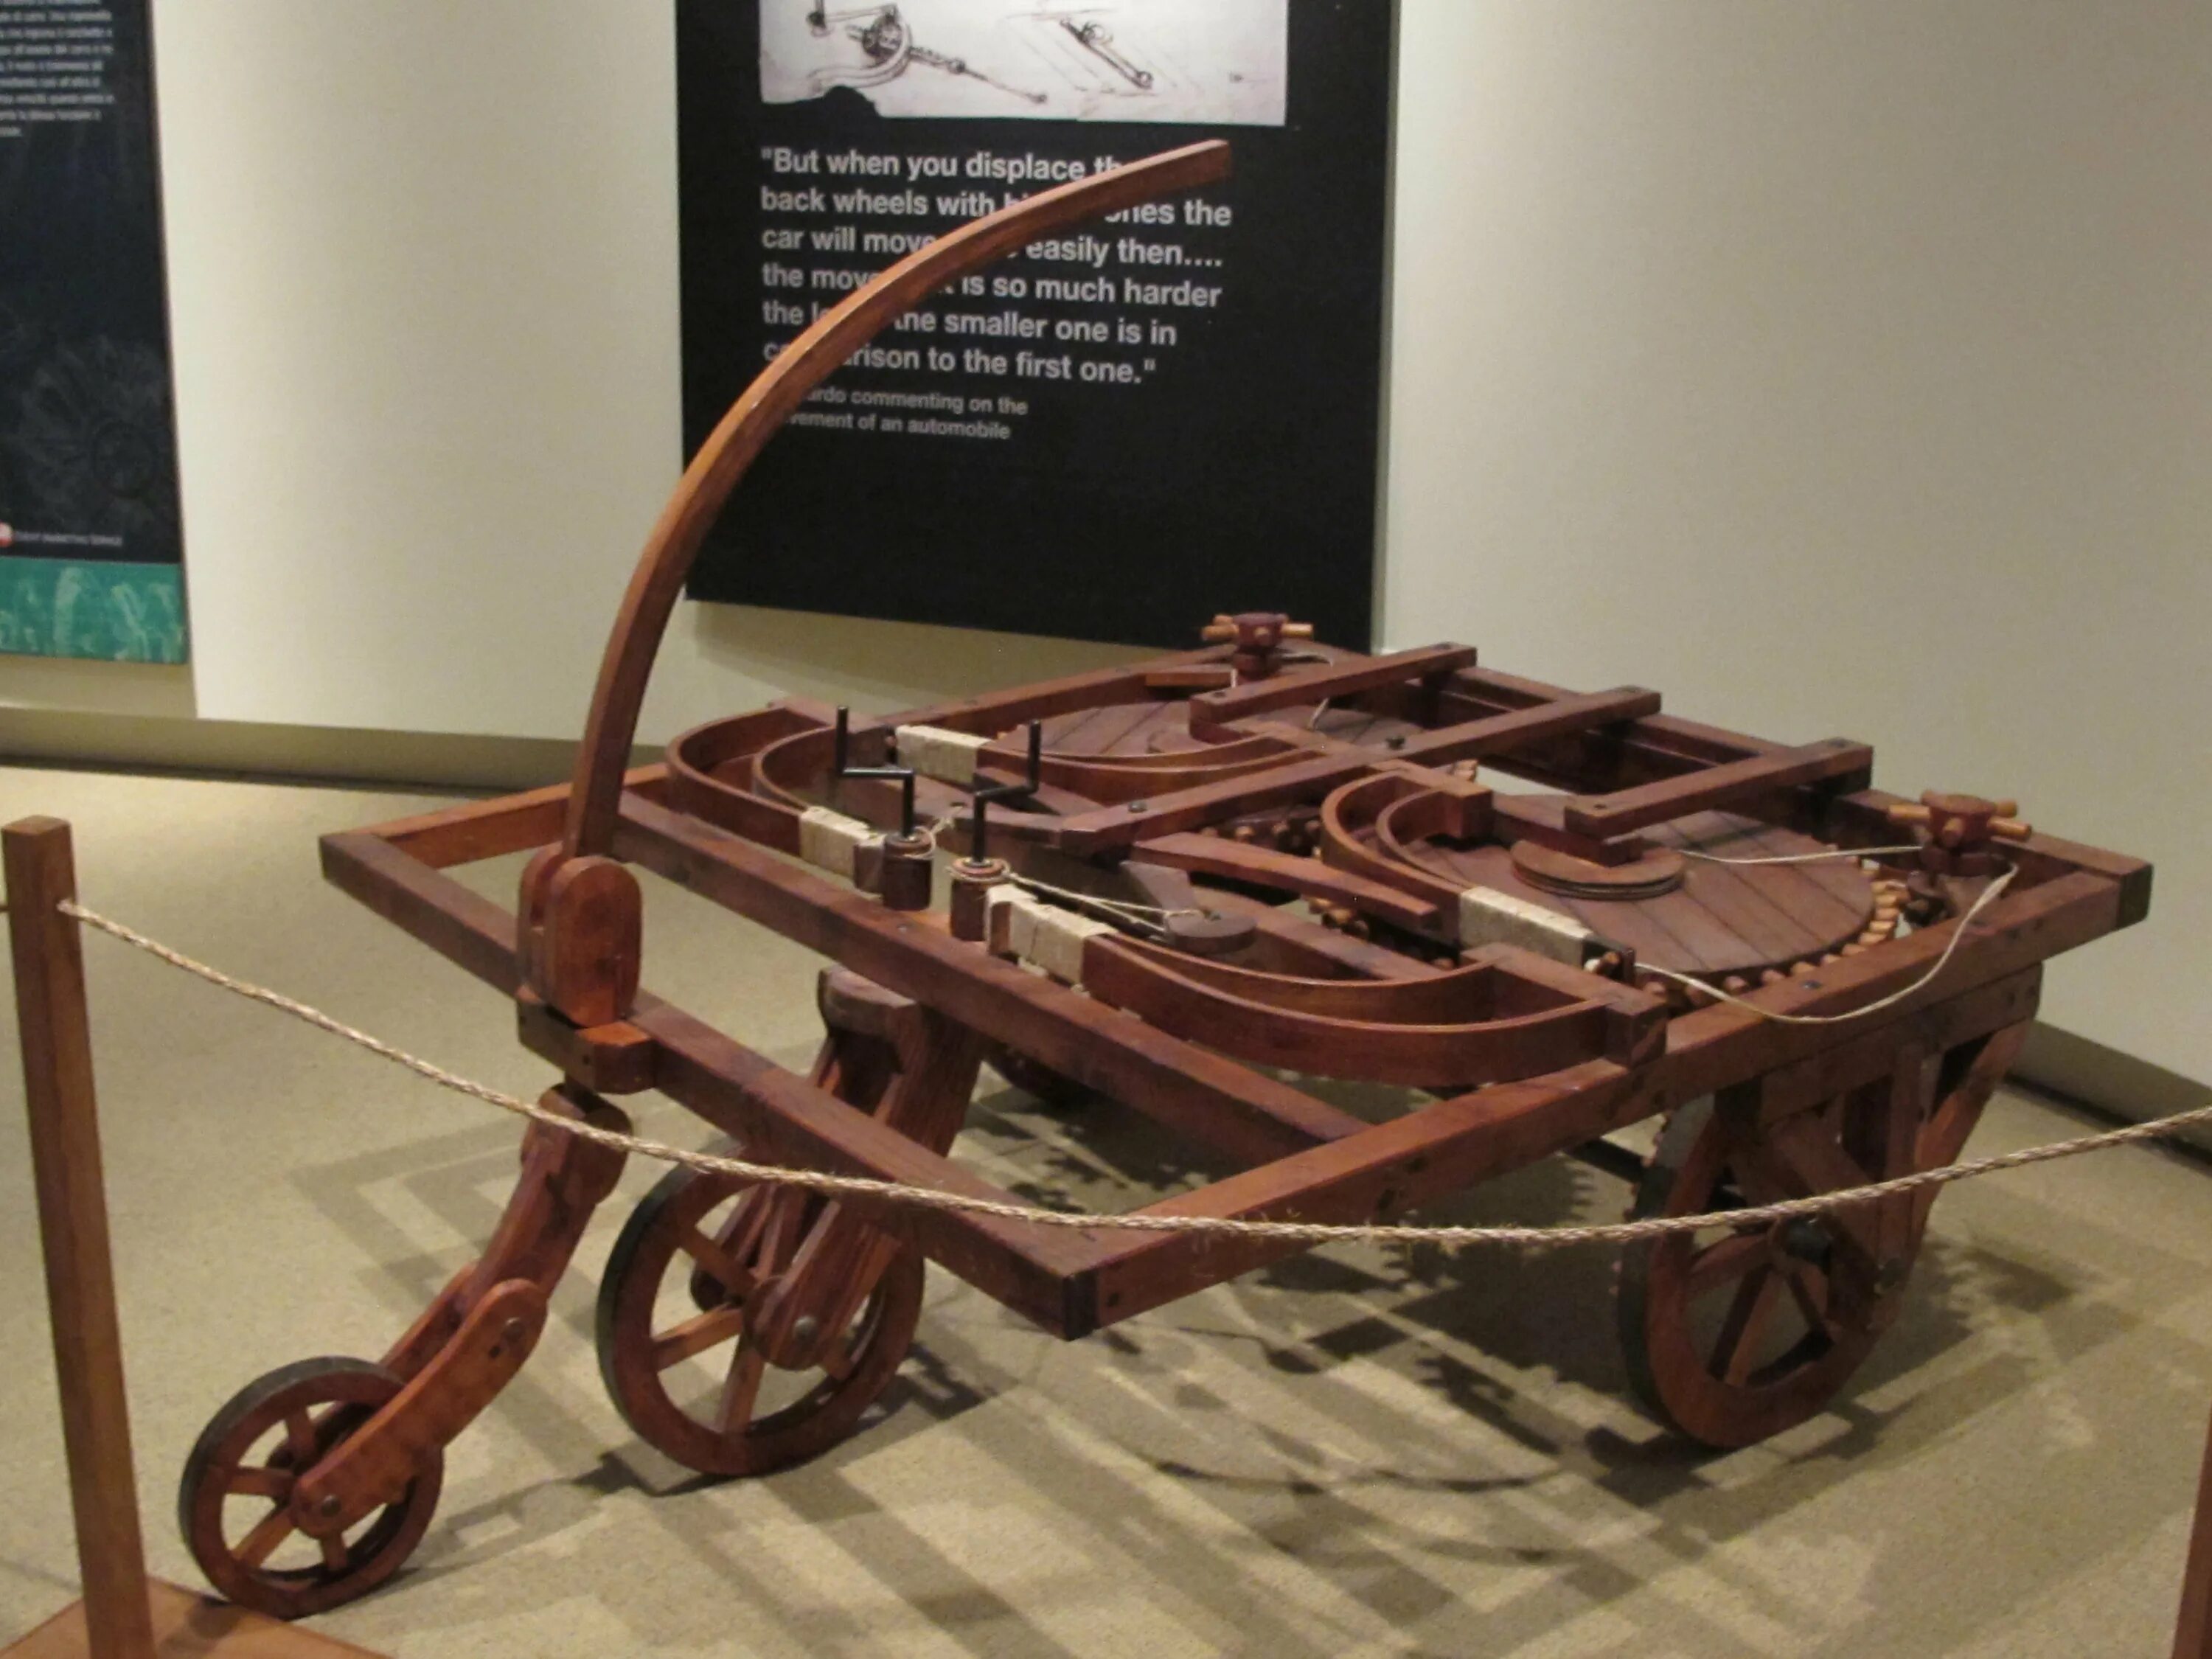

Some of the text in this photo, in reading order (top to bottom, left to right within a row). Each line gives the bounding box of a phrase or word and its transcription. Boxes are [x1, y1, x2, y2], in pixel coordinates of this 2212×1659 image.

[761, 147, 1125, 184] "But when you displace th
[761, 186, 826, 211] back
[833, 189, 929, 215] wheels
[936, 192, 995, 217] with
[1183, 198, 1232, 226] the
[762, 229, 805, 249] car
[811, 226, 857, 251] will
[1026, 235, 1109, 268] easily
[762, 263, 804, 288] the
[962, 276, 986, 296] is
[992, 276, 1028, 297] so
[1034, 276, 1116, 302] much
[1124, 277, 1223, 307] harder
[762, 300, 804, 325] the
[944, 310, 1049, 338] smaller
[1054, 320, 1109, 342] one
[1117, 317, 1142, 344] is
[1150, 319, 1178, 346] in
[928, 347, 956, 372] to
[964, 347, 1008, 375] the
[1015, 351, 1072, 380] first
[1079, 358, 1157, 384] one."
[851, 389, 964, 414] commenting
[969, 398, 992, 414] on
[997, 396, 1029, 416] the
[858, 414, 877, 431] of
[880, 417, 903, 432] an
[907, 417, 1011, 440] automobile
